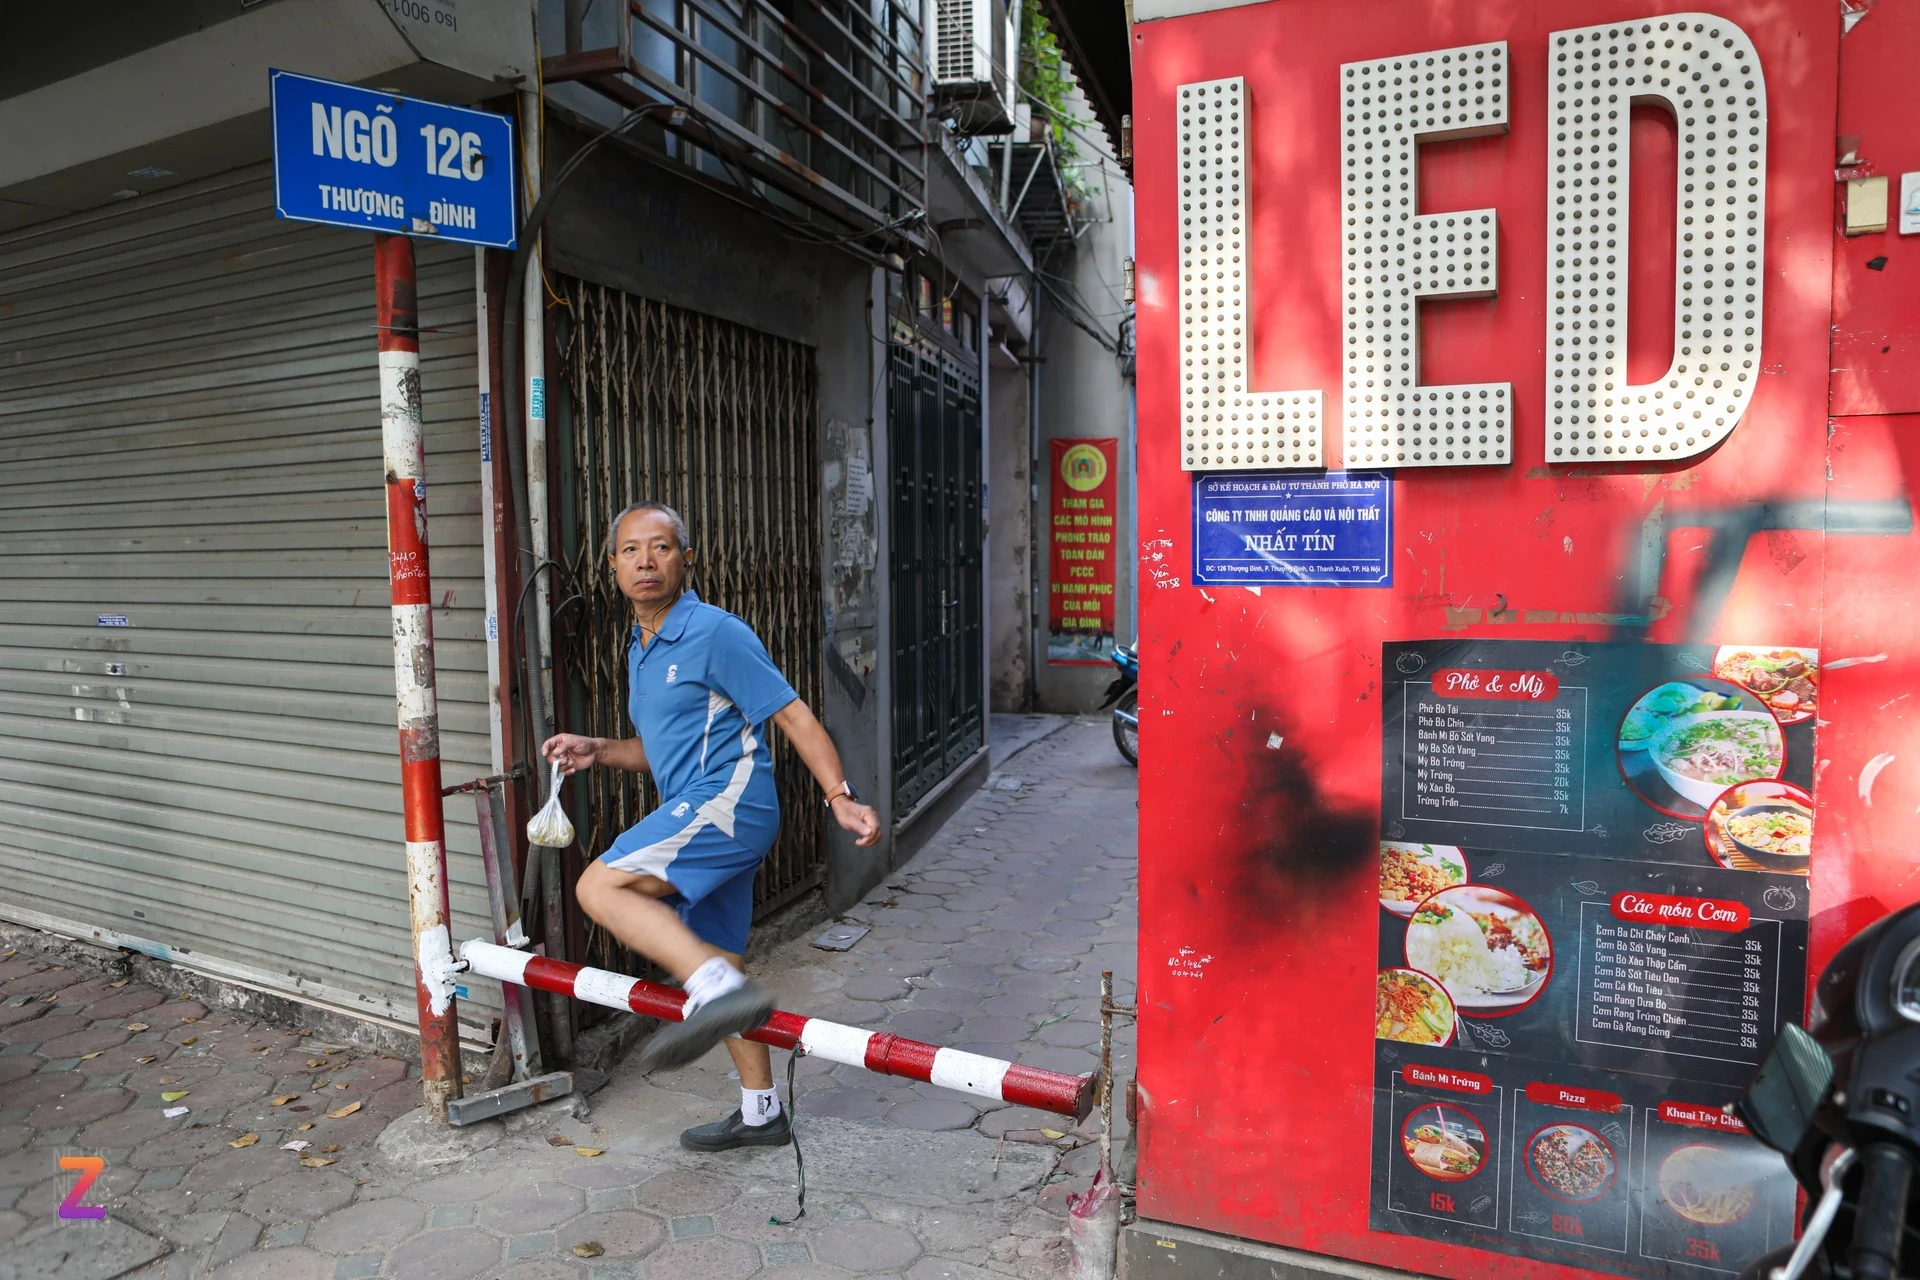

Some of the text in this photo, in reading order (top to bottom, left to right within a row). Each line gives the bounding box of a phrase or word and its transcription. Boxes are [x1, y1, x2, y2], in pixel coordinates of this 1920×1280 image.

[311, 102, 484, 181] NGÕ 126
[319, 184, 476, 229] THƯỢNG ĐÌNH
[1177, 12, 1767, 471] LED
[1208, 482, 1218, 491] SỞ
[1220, 482, 1231, 491] KẾ
[1233, 484, 1260, 492] HOẠCH
[1289, 482, 1299, 490] TƯ
[1301, 481, 1329, 489] THÀNH
[1332, 480, 1348, 489] PHỐ
[1365, 480, 1380, 490] NỘI
[1062, 498, 1104, 509] THAM GIA
[1206, 505, 1380, 523] CÔNG TY TNHH QUẢNG CÁO VÀ NỘI THẤT
[1055, 533, 1085, 542] PHONG
[1245, 527, 1335, 551] NHẤT TÍN
[1071, 567, 1094, 577] PCCC
[1063, 617, 1076, 627] GIA
[1447, 673, 1545, 698] Phở & Mỳ
[1419, 703, 1571, 719] Phở Bò Tái 35k
[1419, 716, 1571, 733] Phở Bò Chín 35k
[1419, 730, 1437, 739] Bánh
[1450, 731, 1459, 740] Bò
[1462, 732, 1474, 741] Sốt
[1476, 733, 1495, 744] Vang
[1556, 736, 1570, 746] 35k
[1431, 743, 1440, 753] Bò
[1442, 744, 1455, 753] Sốt
[1457, 745, 1476, 757] Vang
[1555, 750, 1570, 760] 35k
[1431, 756, 1440, 766] Bò
[1442, 757, 1464, 769] Trứng
[1555, 764, 1569, 773] 35k
[1430, 770, 1452, 782] Trứng
[1554, 777, 1569, 787] 20k
[1429, 783, 1443, 792] Xào
[1446, 784, 1455, 793] Bò
[1554, 791, 1569, 800] 35k
[1417, 795, 1439, 807] Trứng
[1560, 804, 1568, 814] 7k
[1620, 895, 1738, 922] Các món Cơm
[1597, 925, 1614, 936] Cơm
[1617, 927, 1628, 937] Ba
[1669, 932, 1689, 944] Cạnh
[1745, 940, 1762, 951] 35k
[1596, 938, 1761, 965] Cơm Bò Sốt Vang 35k
[1595, 952, 1613, 963] Cơm
[1616, 954, 1626, 964] Bò
[1628, 955, 1643, 966] Xào
[1646, 957, 1665, 969] Thập
[1744, 968, 1760, 979] 35k
[1595, 965, 1613, 976] Cơm
[1616, 968, 1625, 977] Bò
[1628, 969, 1642, 979] Sốt
[1644, 970, 1660, 981] Tiêu
[1743, 982, 1760, 993] 35k
[1594, 978, 1759, 1007] Cơm Cá Kho Tiêu 35k
[1594, 992, 1612, 1002] Cơm
[1615, 994, 1635, 1007] Rang
[1656, 999, 1666, 1009] Bò
[1742, 1009, 1758, 1021] 35k
[1593, 1005, 1758, 1035] Cơm Rang Trứng Chiên 35k
[1593, 1018, 1611, 1029] Cơm
[1626, 1022, 1646, 1035] Rang
[1649, 1025, 1670, 1038] Gừng
[1741, 1037, 1757, 1048] 35k
[1413, 1070, 1480, 1090] Bánh Mì Trứng
[1667, 1106, 1717, 1123] Khoai Tây
[1430, 1192, 1455, 1213] 15k
[1551, 1213, 1584, 1236] 60k
[1685, 1237, 1720, 1263] 35k
